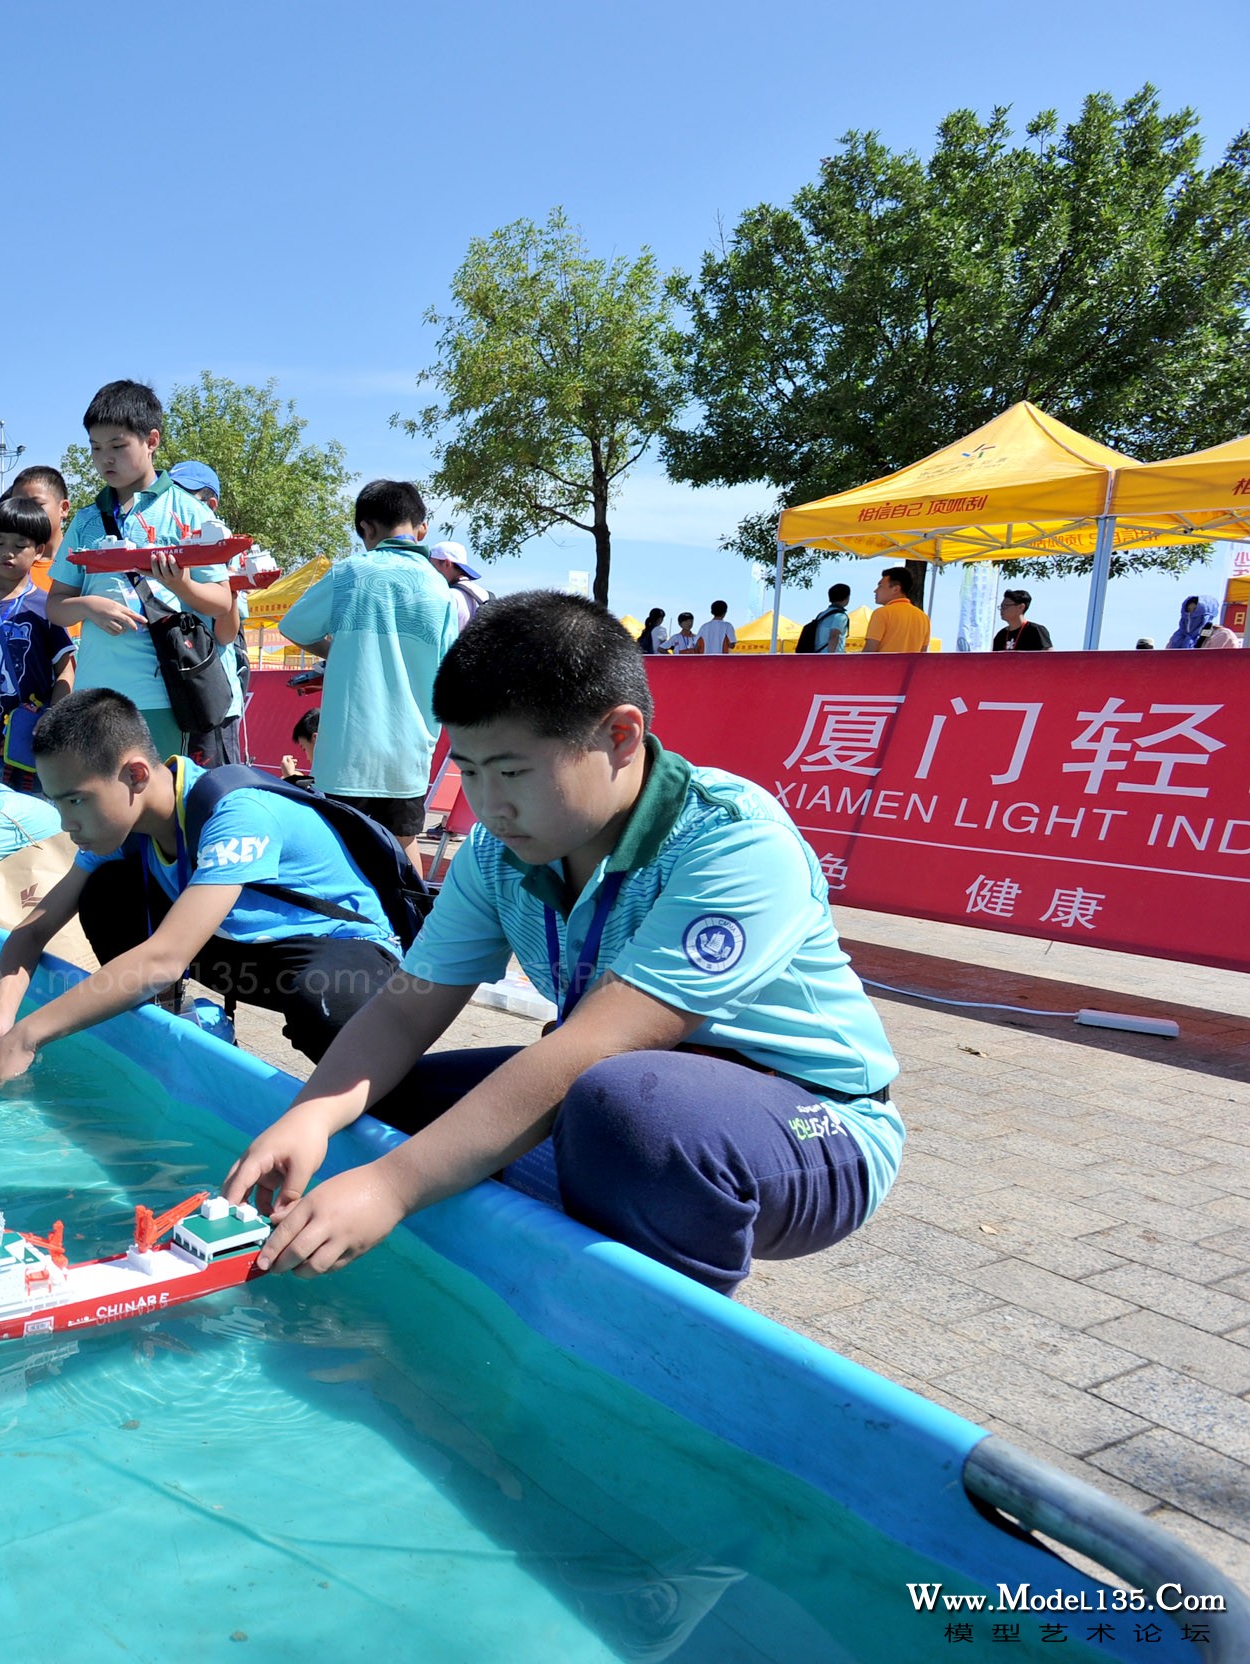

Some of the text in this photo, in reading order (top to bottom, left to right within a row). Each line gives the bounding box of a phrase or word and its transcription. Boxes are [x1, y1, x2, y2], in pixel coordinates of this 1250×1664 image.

[858, 502, 923, 522] 相信自己
[783, 693, 1227, 799] 厦门轻
[773, 780, 1250, 856] XIAMEN LIGHT IND
[965, 873, 1107, 930] 健康
[95, 1292, 170, 1319] CHINARE
